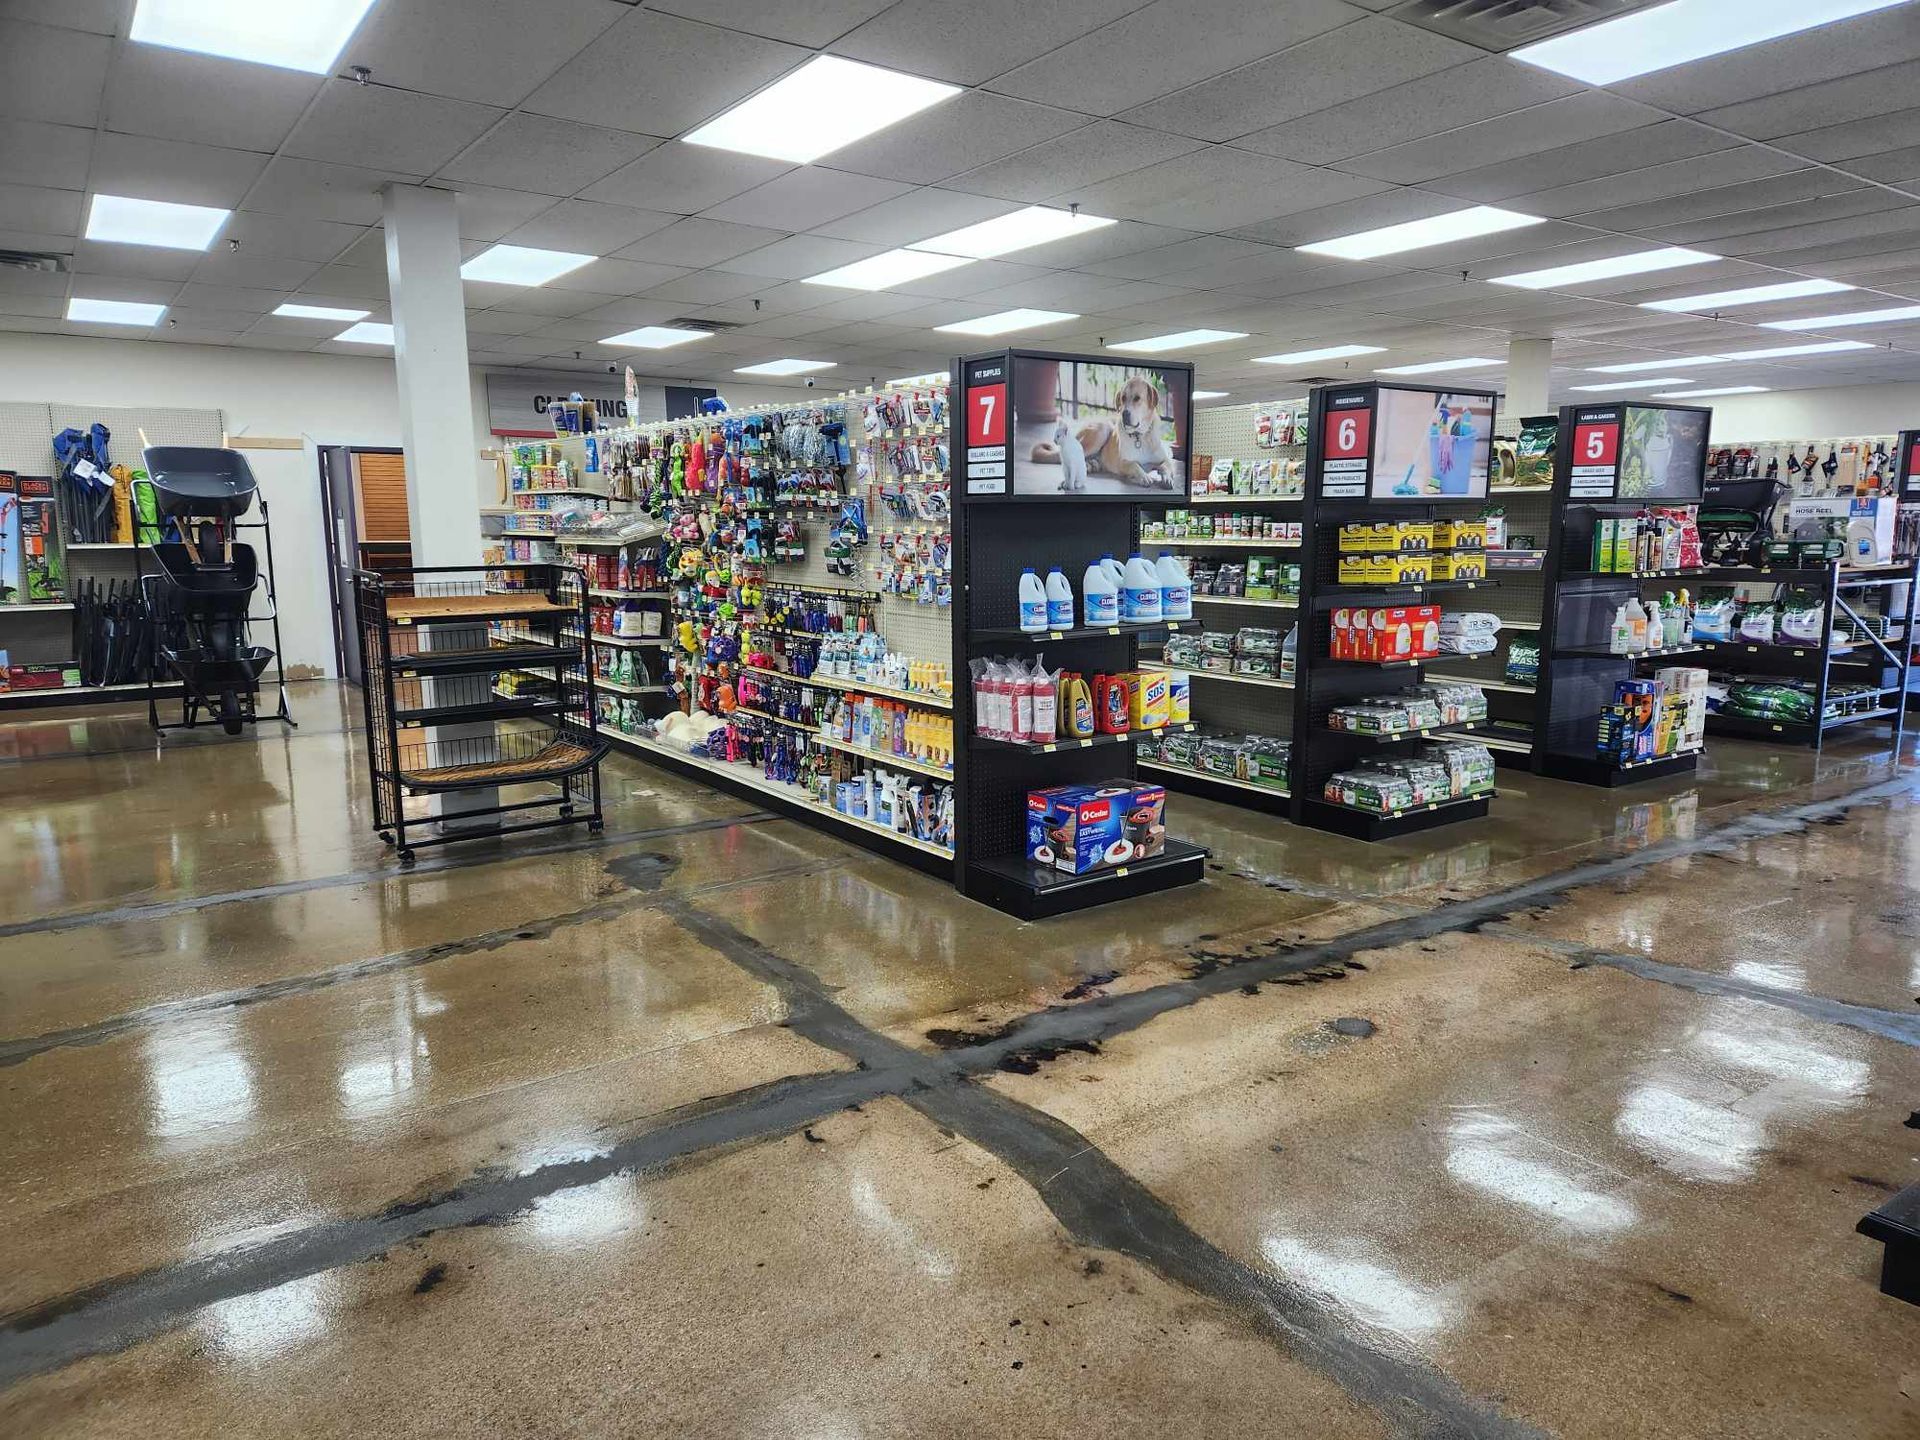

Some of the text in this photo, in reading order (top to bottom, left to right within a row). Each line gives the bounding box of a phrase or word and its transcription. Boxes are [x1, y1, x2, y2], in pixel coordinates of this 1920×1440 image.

[980, 396, 995, 435] 7
[1339, 418, 1356, 450] 6
[1587, 431, 1604, 458] 5
[1147, 683, 1165, 701] SOS
[1081, 810, 1109, 821] O-Cedar
